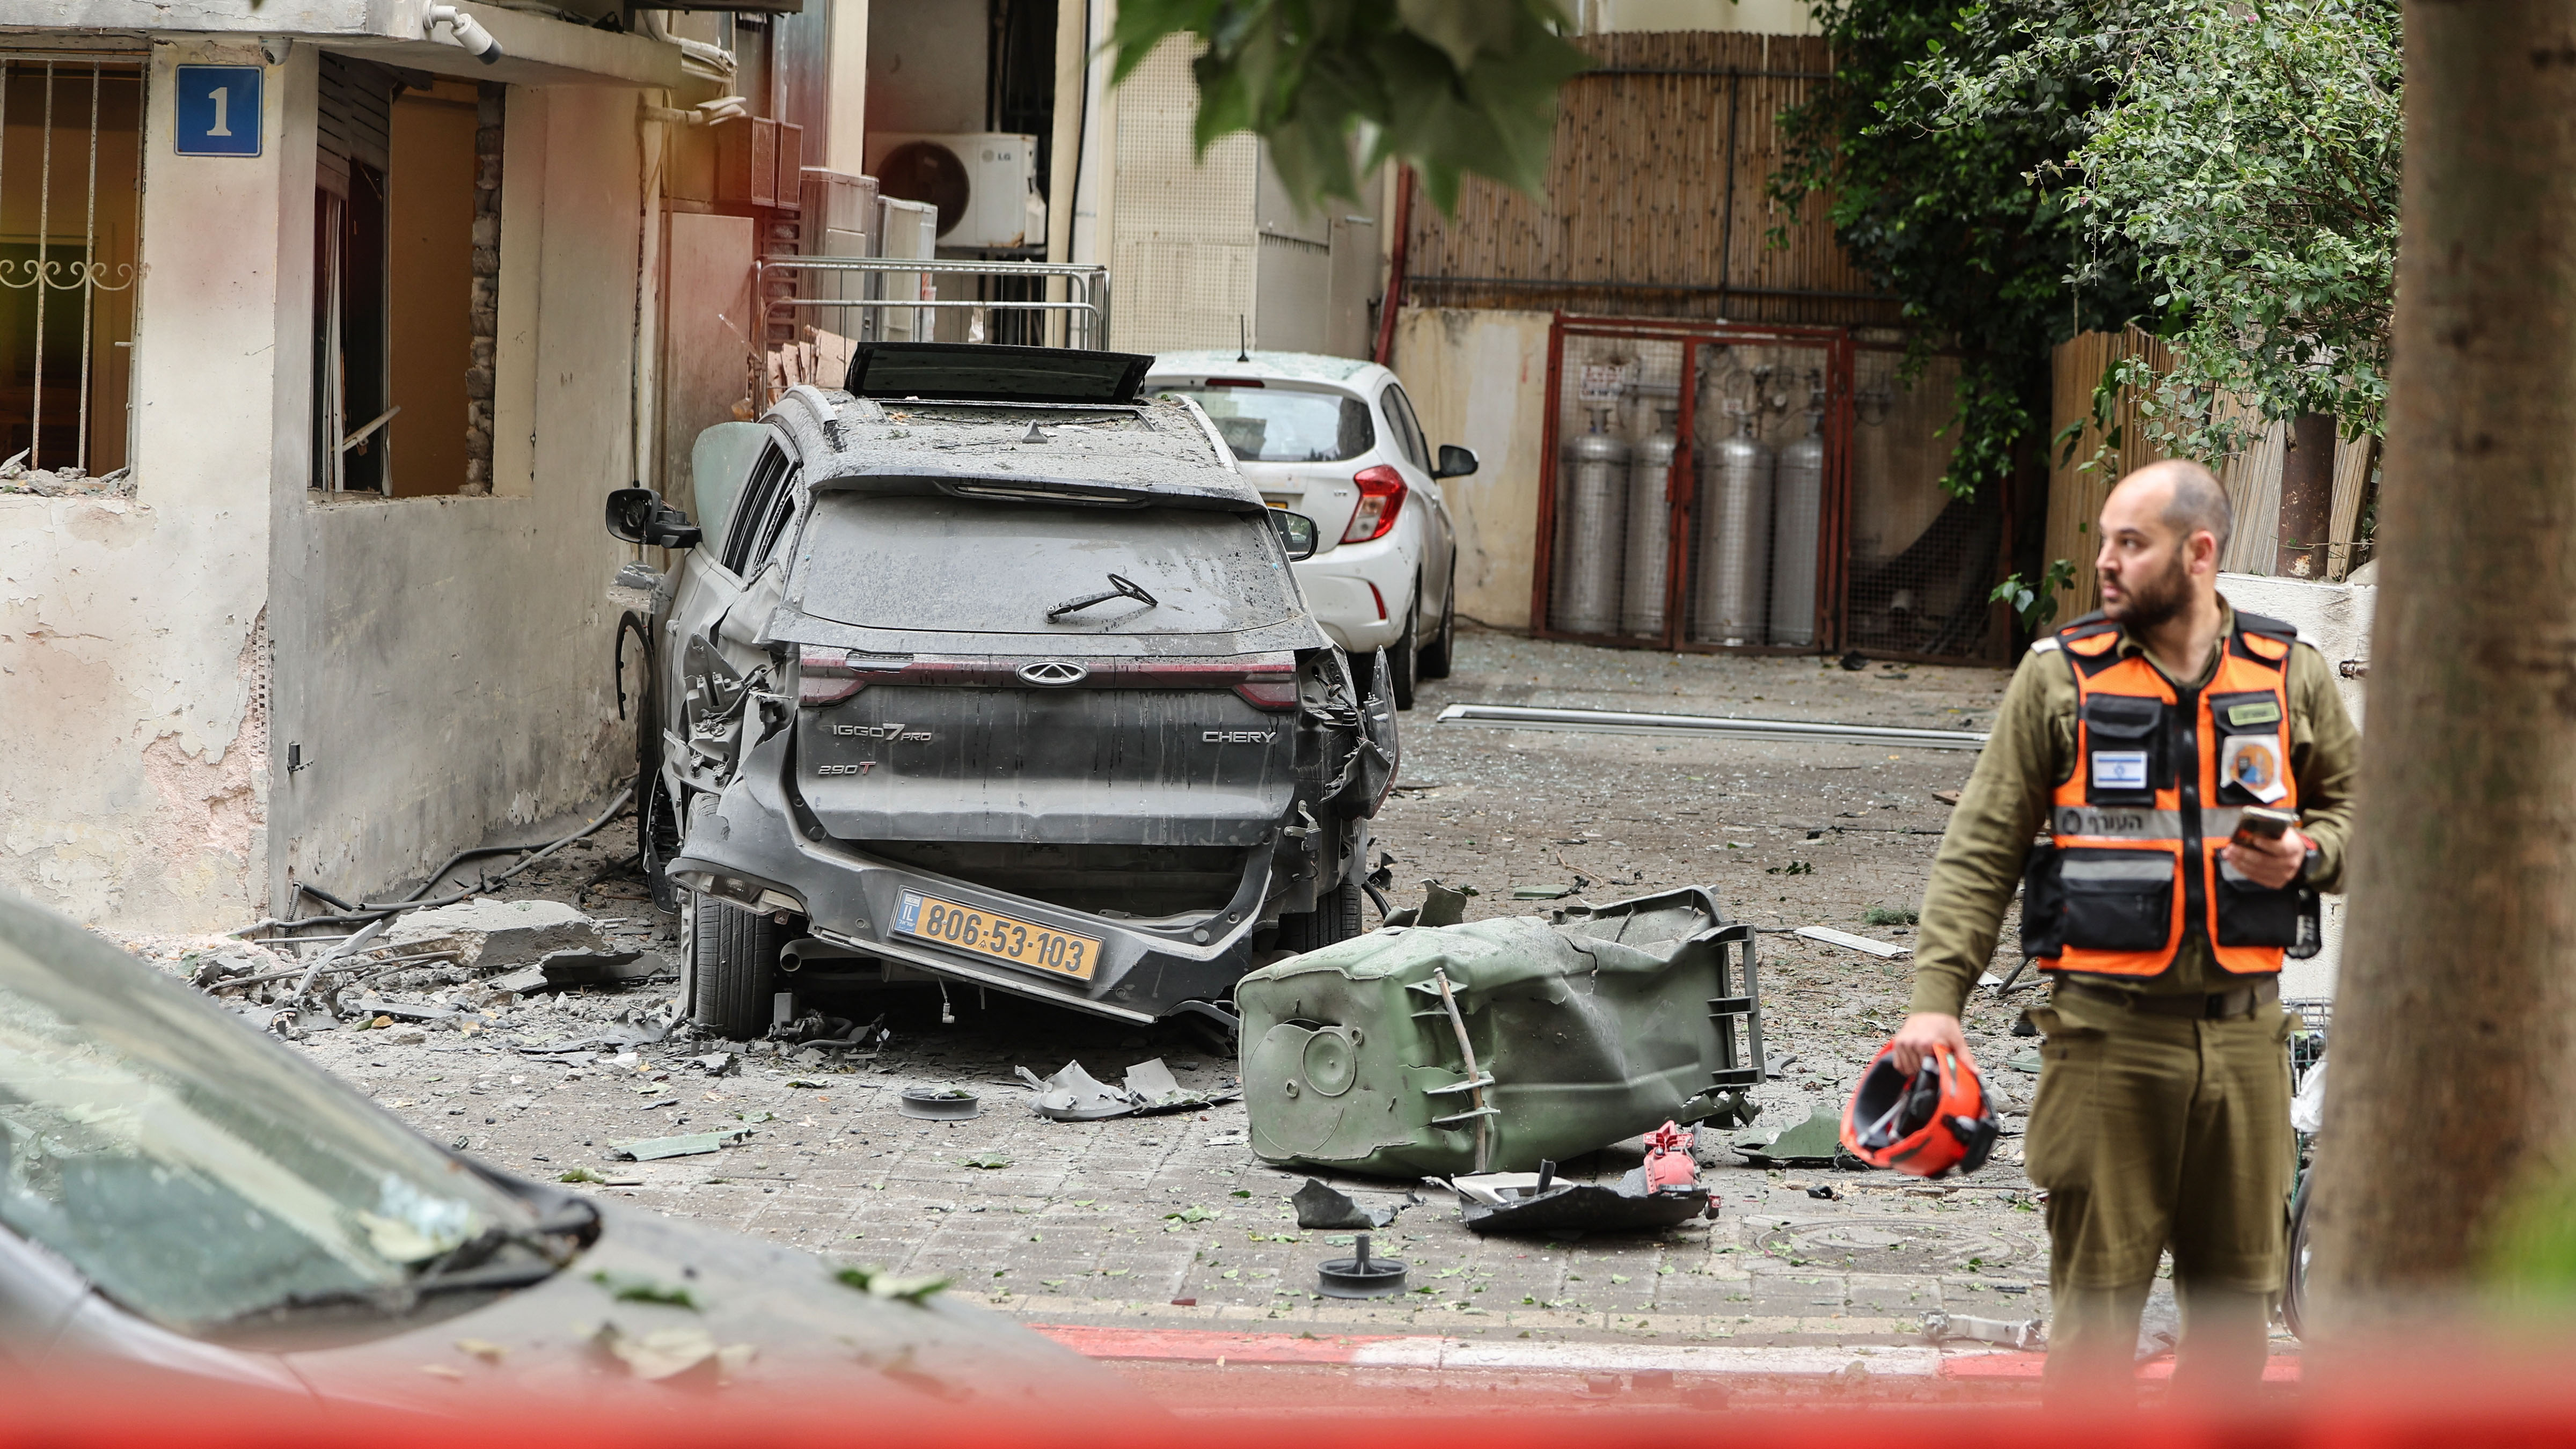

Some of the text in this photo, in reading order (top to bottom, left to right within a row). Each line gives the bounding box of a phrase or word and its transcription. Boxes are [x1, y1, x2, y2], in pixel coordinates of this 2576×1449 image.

[207, 86, 232, 136] 1
[998, 152, 1011, 160] LG
[900, 732, 932, 741] PRO
[1202, 731, 1277, 743] CHERY
[818, 761, 876, 774] 290T
[902, 905, 913, 921] IL
[898, 919, 916, 927] ישראל
